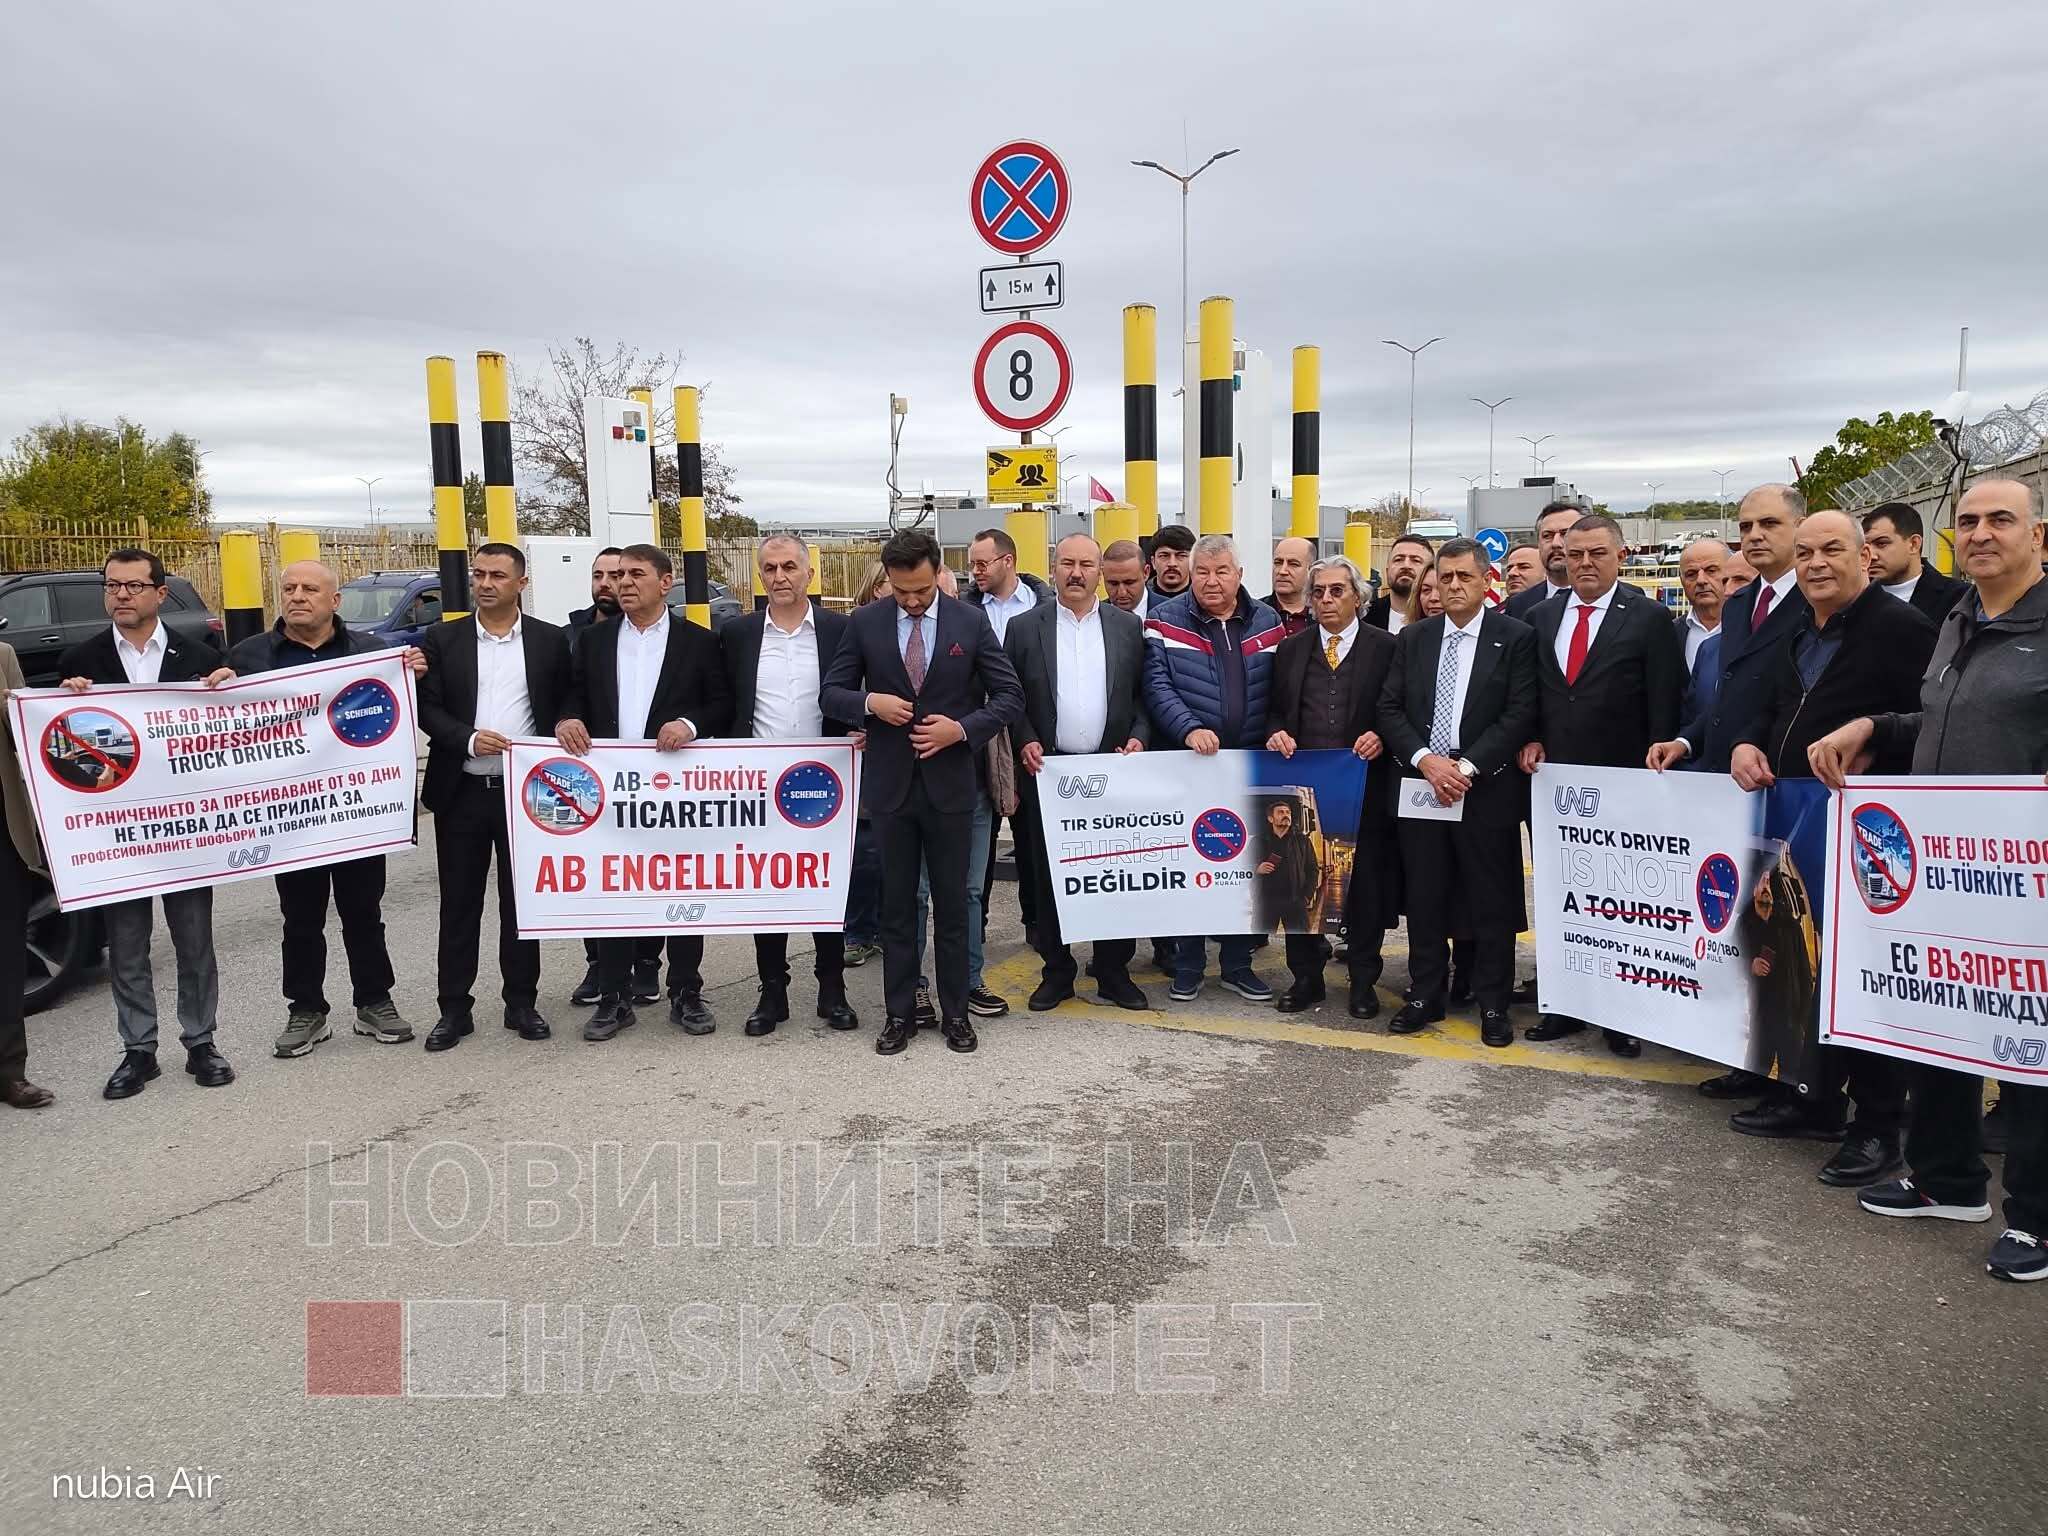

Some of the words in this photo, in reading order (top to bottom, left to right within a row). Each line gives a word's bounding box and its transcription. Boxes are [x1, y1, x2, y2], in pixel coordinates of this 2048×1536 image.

[1009, 349, 1033, 401] 8
[144, 710, 174, 725] THE
[179, 705, 235, 722] 90-DAY
[241, 699, 278, 716] STAY
[282, 693, 321, 711] LIMIT
[147, 723, 200, 739] SHOULD
[205, 720, 229, 733] NOT
[234, 718, 249, 730] BE
[254, 709, 302, 728] APPLIED
[306, 706, 319, 717] TO
[345, 705, 383, 720] SCHENGEN
[166, 720, 307, 757] PROFESSIONAL
[168, 751, 228, 775] TRUCK
[232, 738, 311, 765] DRIVERS.
[64, 801, 195, 830] ОГРАНИЧЕНИЕТО
[200, 798, 219, 812] ЗА
[224, 778, 325, 809] ПРЕБИВАВАНЕ
[328, 774, 344, 790] ОТ
[350, 771, 366, 786] 90
[371, 766, 401, 785] ДНИ
[544, 772, 572, 790] TRADE
[790, 790, 828, 799] SCHENGEN
[115, 826, 136, 843] НЕ
[141, 816, 208, 840] ТРЯБВА
[214, 811, 238, 832] ДА
[243, 808, 262, 824] СЕ
[267, 794, 338, 821] ПРИЛАГА
[342, 789, 364, 806] ЗА
[612, 792, 767, 829] TİCARETİNİ
[1060, 817, 1088, 832] TIR
[1092, 810, 1184, 830] SÜRÜCÜSÜ
[71, 838, 192, 866] ПРОФЕСИОНАЛНИТЕ
[196, 828, 256, 848] ШОФЬОРИ
[260, 823, 275, 837] НА
[277, 814, 327, 834] ТОВАРНИ
[330, 801, 407, 824] АВТОМОБИЛИ.
[1061, 832, 1185, 866] TURİST
[1558, 825, 1617, 847] TRUCK
[1621, 831, 1690, 856] DRIVER
[1857, 824, 1883, 850] TRADE
[1922, 835, 1952, 860] THE
[1958, 837, 1976, 861] EU
[1982, 838, 1999, 862] IS
[535, 855, 587, 893] AB
[602, 843, 830, 892] ENGELLİYOR!
[1065, 866, 1187, 896] DEĞİLDİR
[1214, 870, 1253, 880] 90/180
[1560, 848, 1595, 888] IS
[1606, 853, 1692, 902] NOT
[1926, 863, 2026, 898] EU-TÜRKİYE
[1562, 891, 1580, 914] A
[1585, 894, 1692, 934] TOURIST
[1564, 932, 1630, 954] ШОФЬОРЪТ
[1633, 945, 1651, 958] НА
[1654, 949, 1696, 971] КАМИОН
[1708, 940, 1740, 957] 90/180
[1565, 949, 1594, 975] НЕ
[1599, 956, 1612, 980] Е
[1617, 960, 1700, 1000] ТУРИСТ
[1890, 942, 1918, 975] ЕС
[1927, 947, 2048, 993] ВЪЗПРЕП
[1860, 968, 1968, 1011] ТЪРГОВИЯТА
